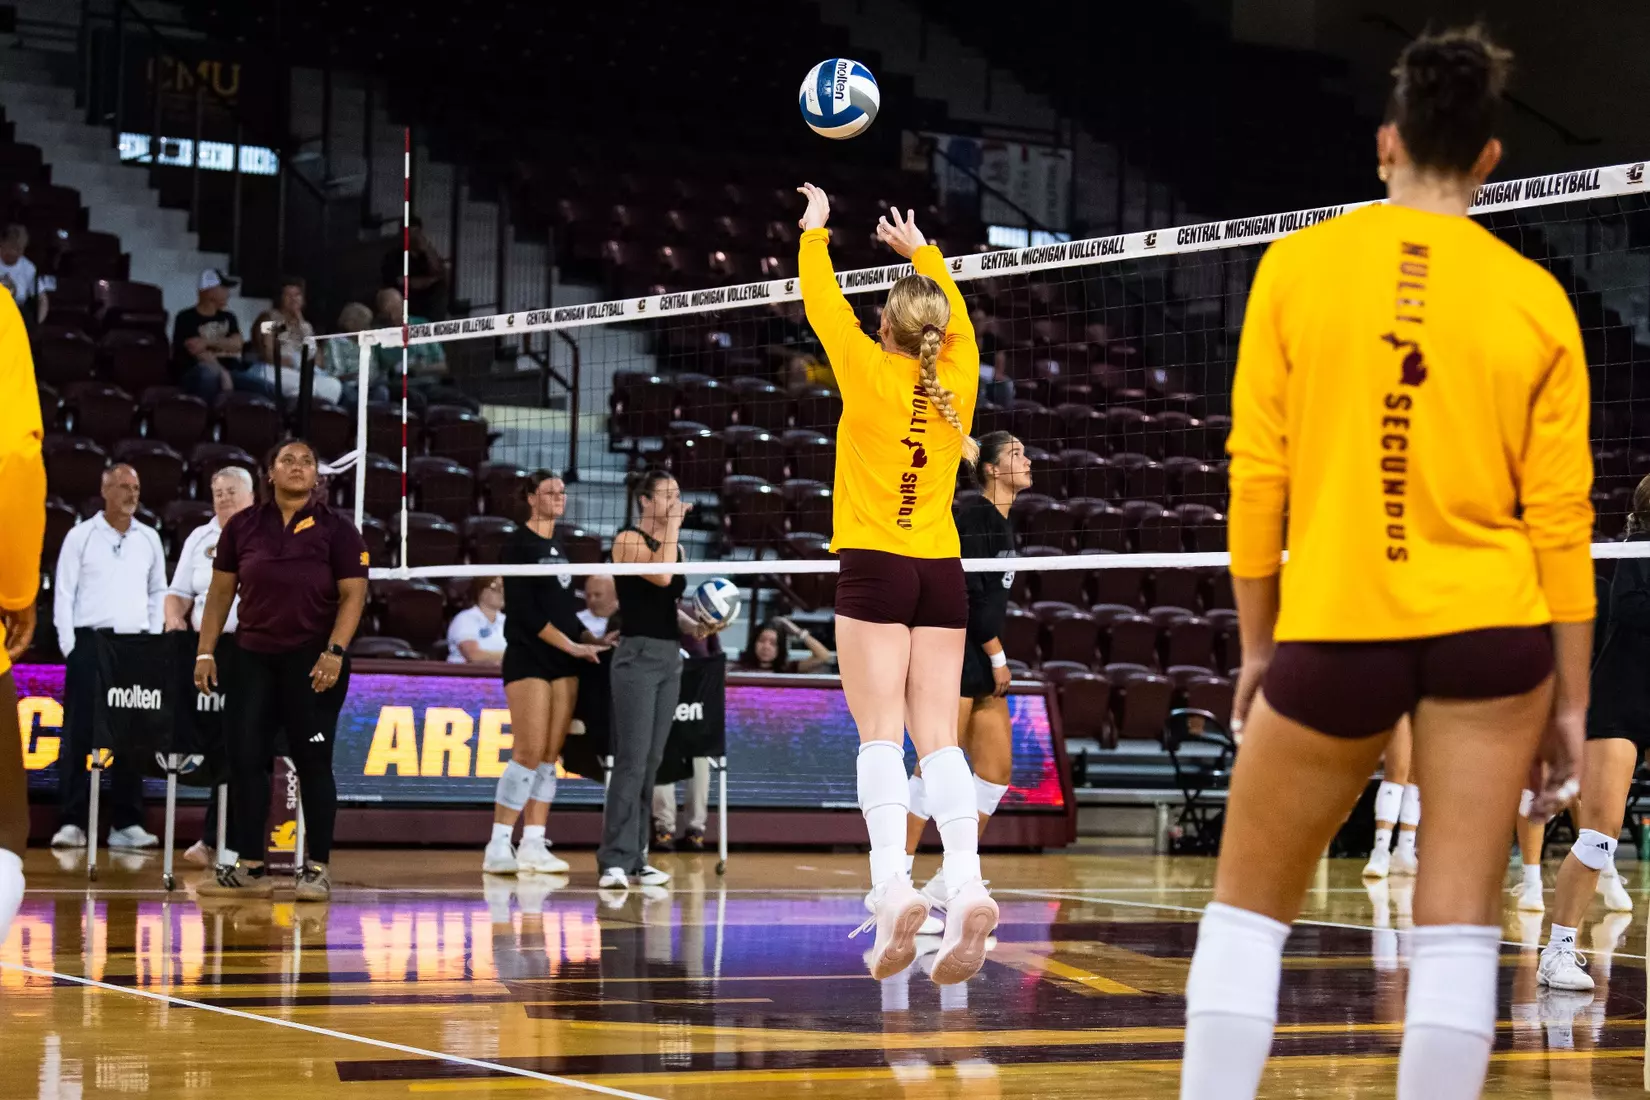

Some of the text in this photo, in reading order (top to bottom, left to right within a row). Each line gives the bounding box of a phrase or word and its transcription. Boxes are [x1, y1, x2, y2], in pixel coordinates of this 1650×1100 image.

[834, 61, 848, 99] molten
[526, 310, 553, 326] CENTRAL
[554, 306, 585, 322] MICHIGAN
[586, 301, 625, 320] VOLLEYBALL
[660, 294, 689, 311] CENTRAL
[691, 289, 725, 308] MICHIGAN
[727, 283, 770, 304] VOLLEYBALL
[845, 267, 885, 289] MICHIGAN
[981, 250, 1018, 271] CENTRAL
[1021, 243, 1066, 266] MICHIGAN
[1069, 236, 1125, 259] VOLLEYBALL
[1177, 222, 1221, 246] CENTRAL
[1224, 215, 1277, 240] MICHIGAN
[1525, 169, 1601, 200] VOLLEYBALL
[909, 384, 930, 434] NULLI
[1380, 241, 1430, 563] NULLI SECUNDUS
[107, 684, 162, 710] molten
